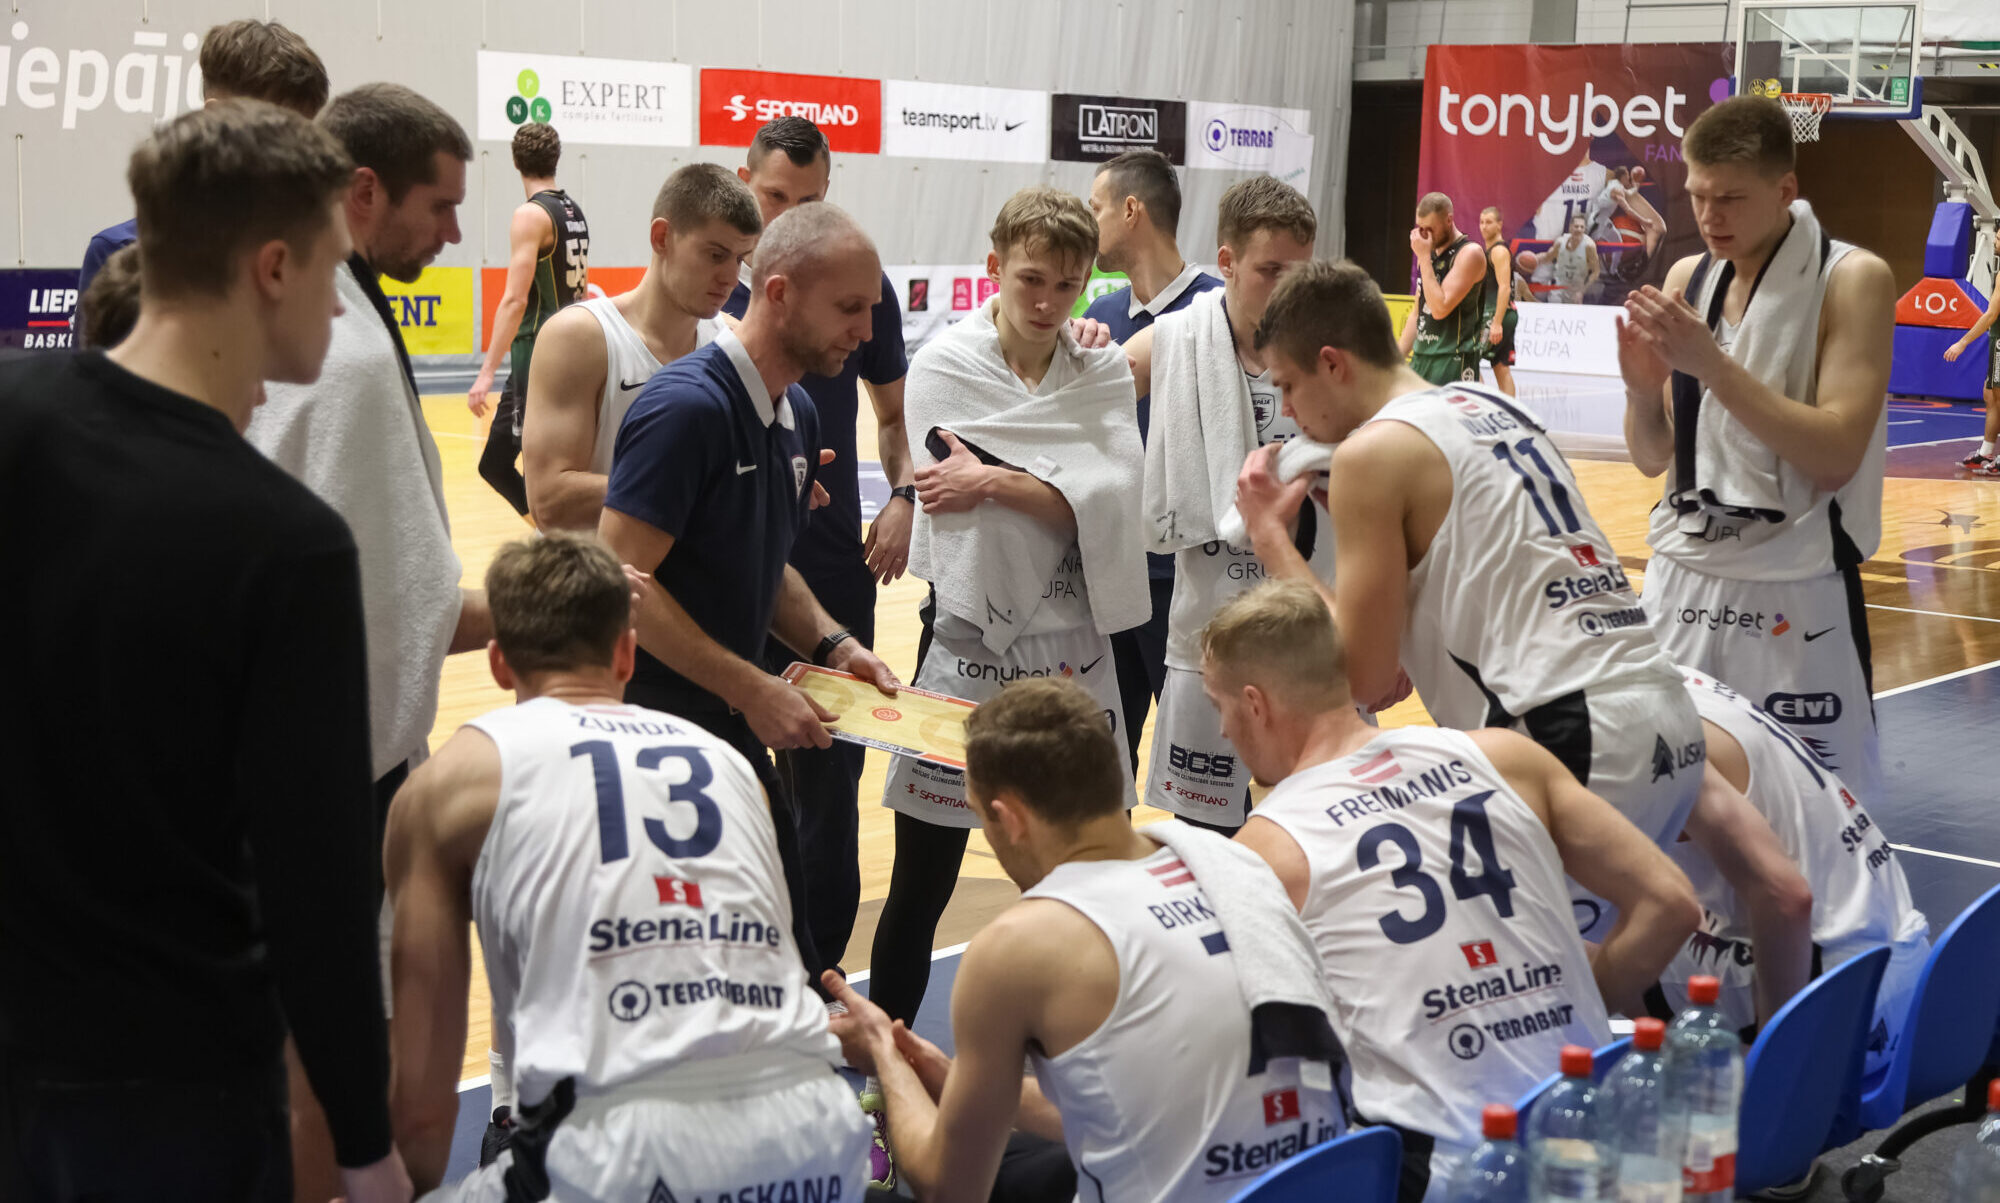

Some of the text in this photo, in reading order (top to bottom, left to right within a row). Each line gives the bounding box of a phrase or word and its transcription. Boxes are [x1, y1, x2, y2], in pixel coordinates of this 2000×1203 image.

[562, 80, 666, 110] EXPERT
[512, 104, 522, 117] N
[755, 99, 859, 126] SPORTLAND
[902, 107, 998, 133] teamsport.lv
[1438, 82, 1687, 156] tonybet
[1230, 128, 1273, 148] TERRAB
[1645, 144, 1683, 162] FAN
[29, 289, 79, 313] LIEP
[1518, 316, 1586, 336] LEANR
[1515, 339, 1570, 358] RUPA
[1491, 437, 1582, 537] 11
[1169, 743, 1234, 778] BCS
[569, 740, 723, 865] 13
[1176, 786, 1229, 807] SPORTLAND
[1325, 760, 1472, 827] FREIMANIS
[1357, 789, 1517, 944] 34
[655, 977, 785, 1009] TERRBAIT
[693, 1174, 842, 1203] SKANA
